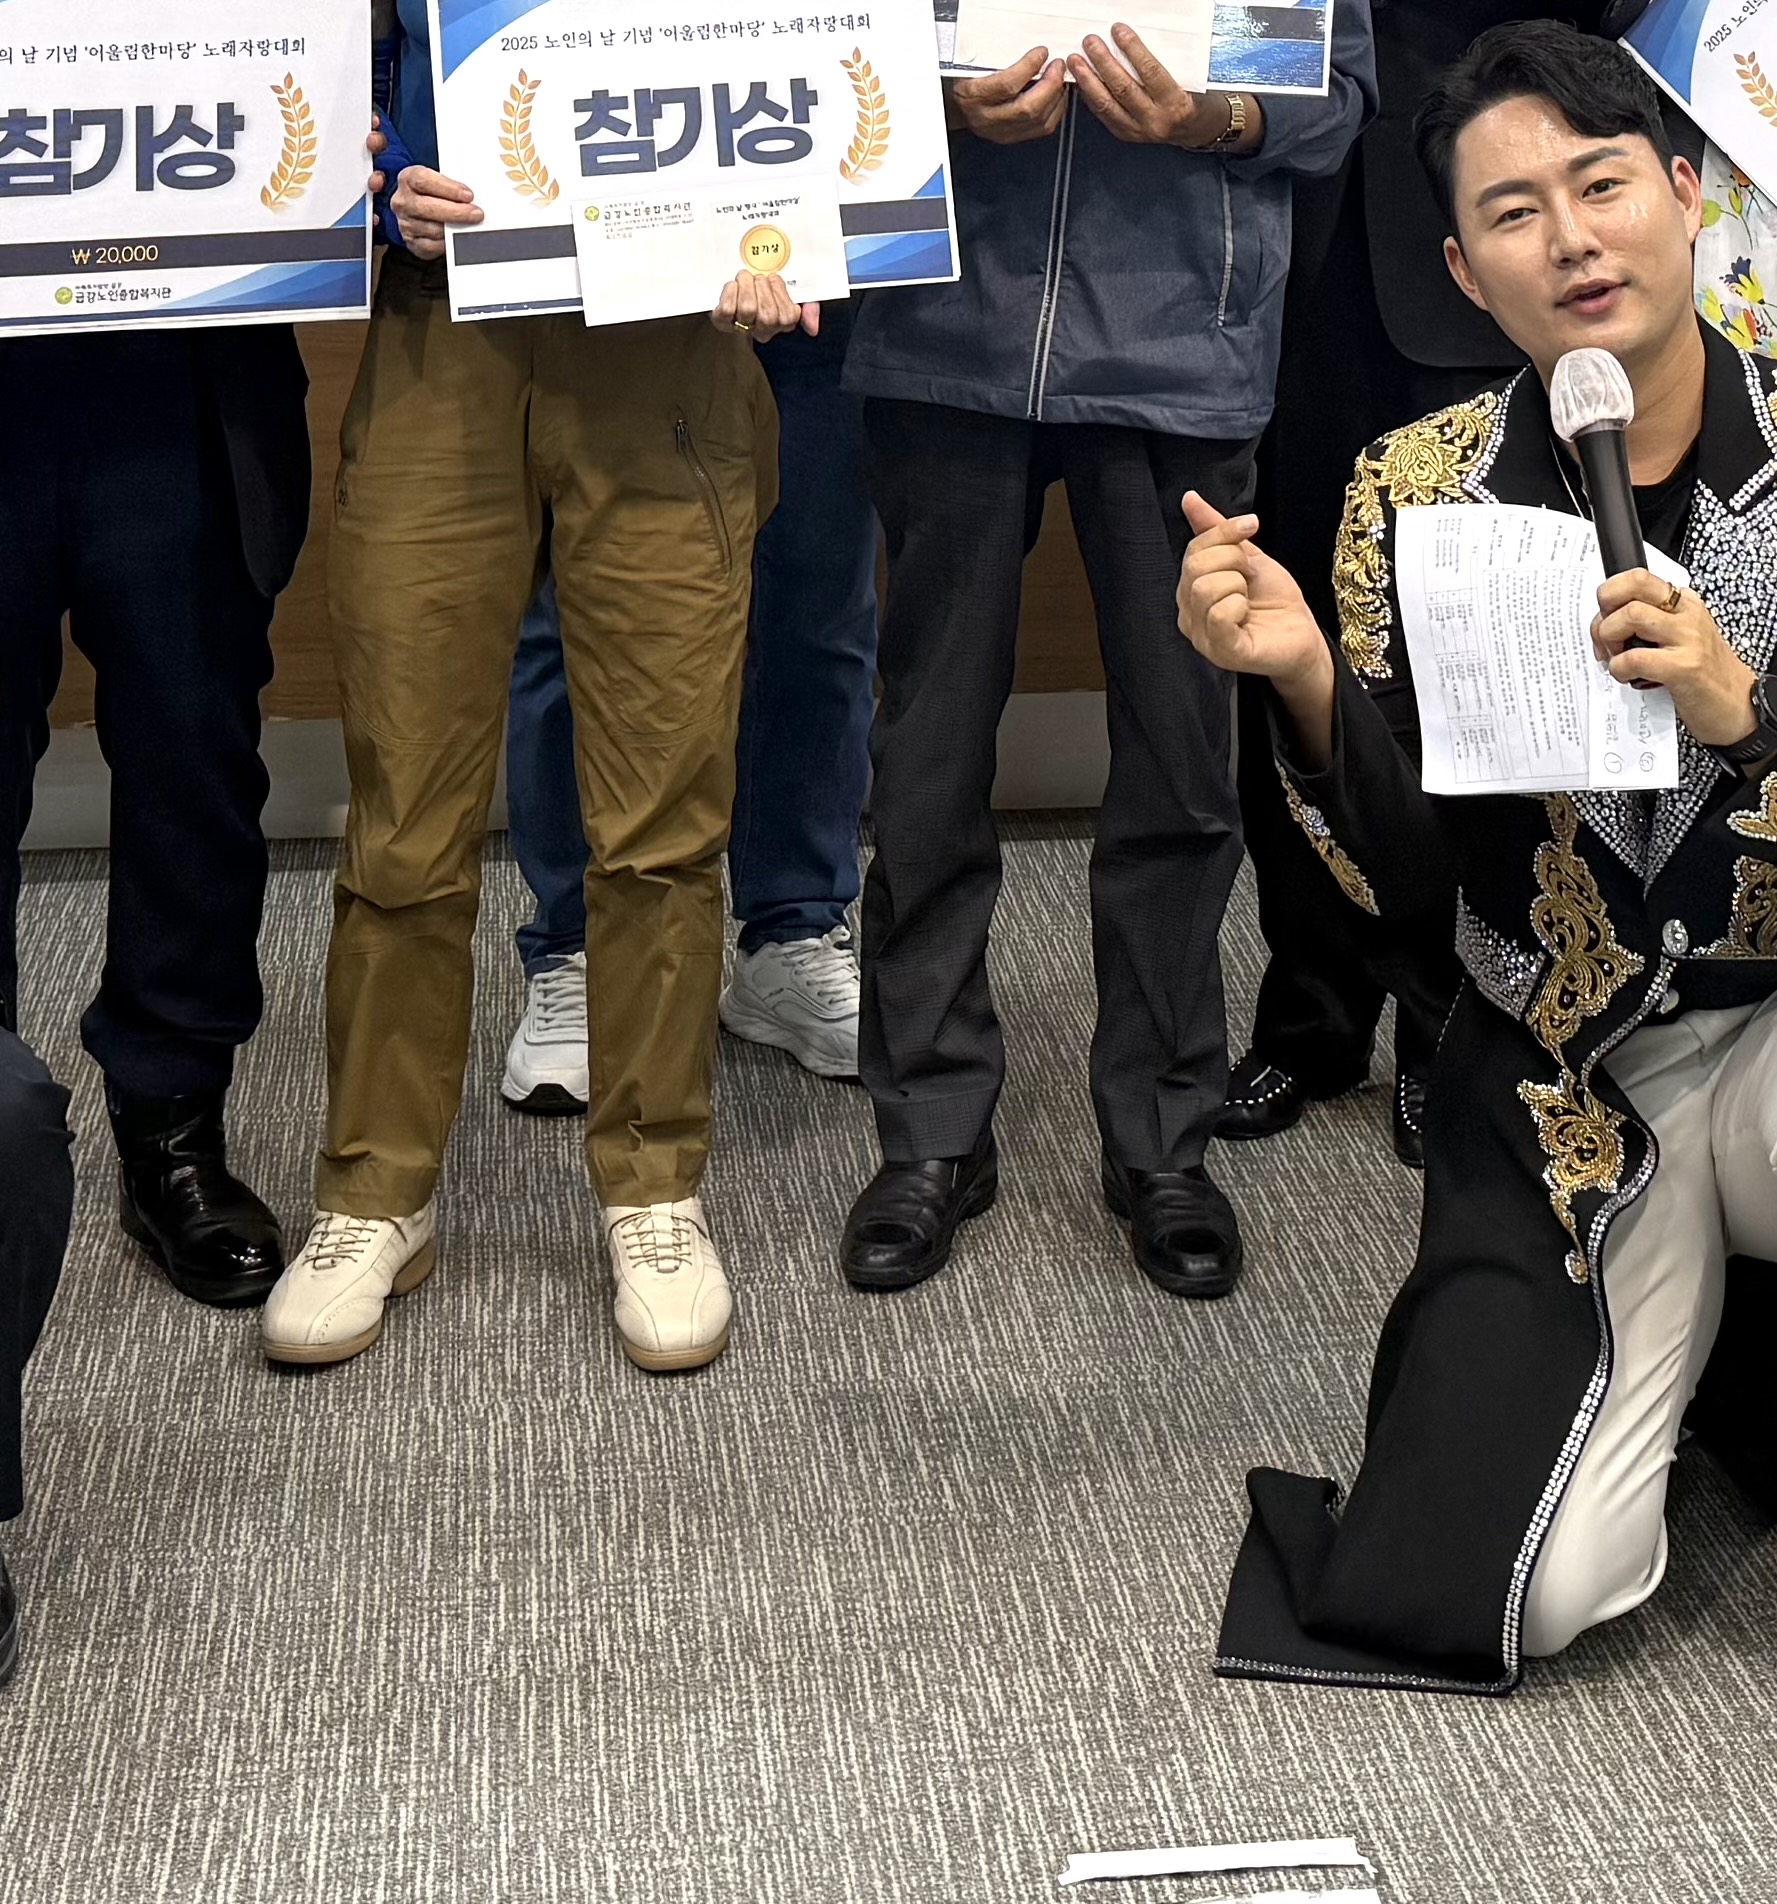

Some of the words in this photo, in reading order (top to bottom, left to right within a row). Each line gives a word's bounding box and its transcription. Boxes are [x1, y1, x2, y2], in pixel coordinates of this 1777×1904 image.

[21, 45, 40, 65] 날
[44, 44, 77, 64] 기념
[202, 36, 306, 59] 노래자랑대회
[500, 35, 538, 52] 2025
[544, 29, 593, 49] 노인의
[1703, 22, 1733, 52] 2025
[573, 77, 819, 178] 참가상
